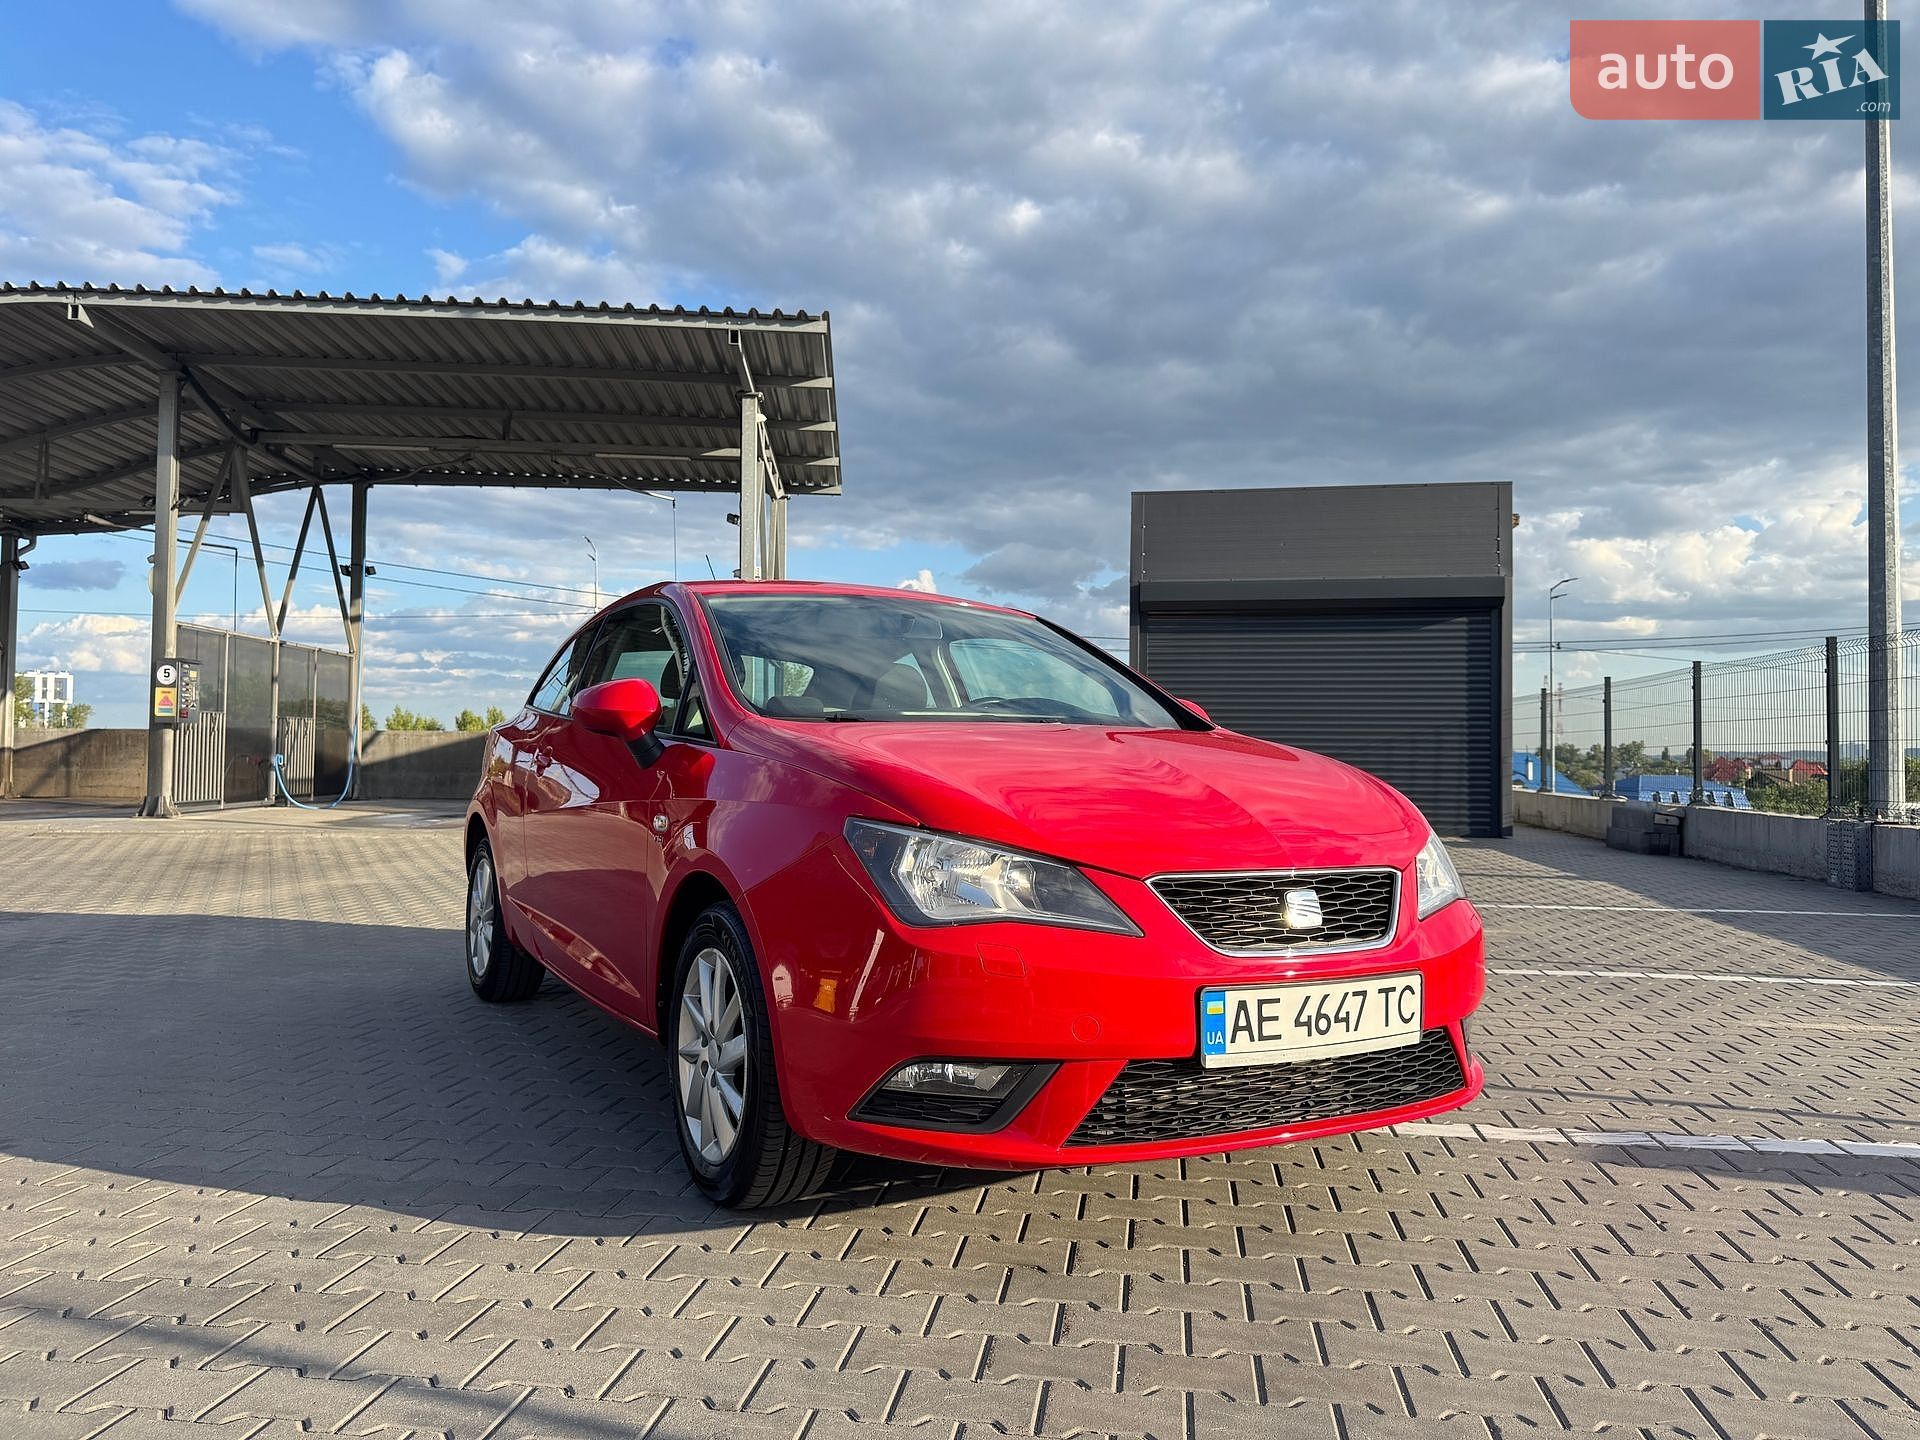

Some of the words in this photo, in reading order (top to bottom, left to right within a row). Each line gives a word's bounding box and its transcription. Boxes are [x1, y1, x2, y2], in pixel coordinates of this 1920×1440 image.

[163, 668, 170, 678] 5
[1229, 997, 1282, 1044] AE
[1294, 989, 1368, 1037] 4647
[1377, 984, 1416, 1027] TC
[1206, 1030, 1225, 1045] UA
